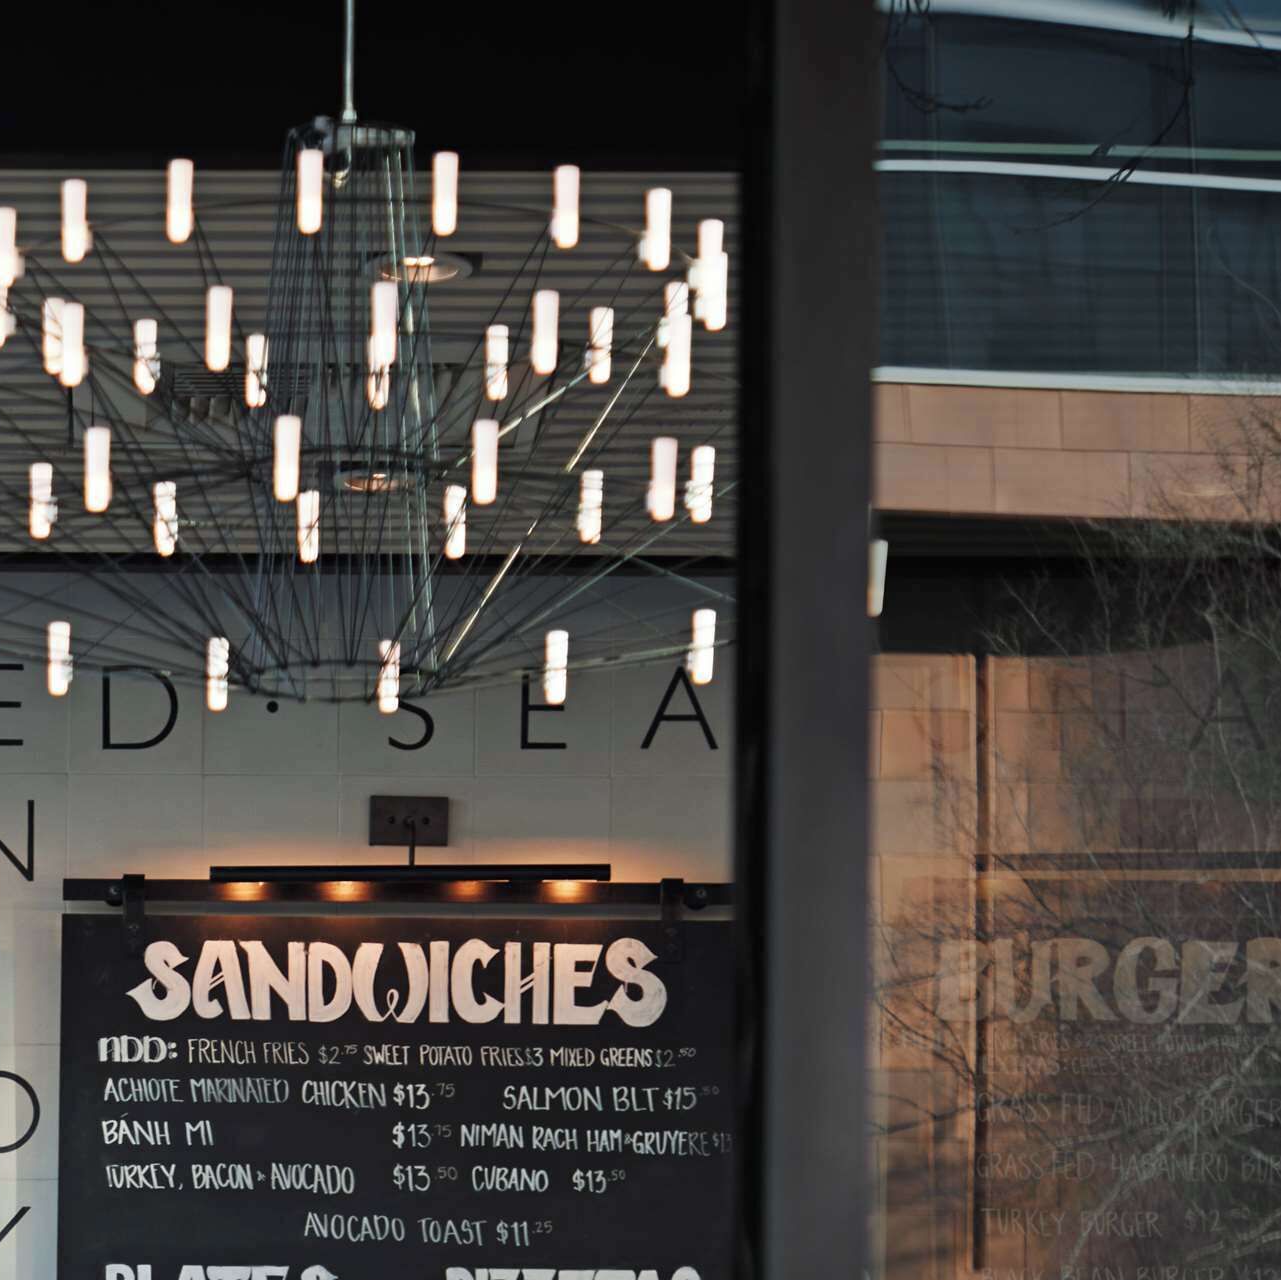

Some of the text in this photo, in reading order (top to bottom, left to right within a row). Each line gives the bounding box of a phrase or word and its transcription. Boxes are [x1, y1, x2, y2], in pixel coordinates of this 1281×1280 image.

[125, 938, 667, 1027] SANDWICHES
[187, 1039, 256, 1064] FRENCH
[263, 1041, 310, 1065] FRIES
[363, 1045, 410, 1066] SWEET
[420, 1046, 472, 1067] POTATO
[480, 1046, 524, 1067] FRIES
[550, 1047, 595, 1067] MIXED
[600, 1049, 652, 1068] GREENS
[104, 1077, 184, 1103] ACHIOTE
[302, 1080, 387, 1109] CHICKEN
[503, 1085, 660, 1112] SALMON BLT
[185, 1120, 214, 1146] MI
[460, 1123, 523, 1149] NIMAN
[532, 1127, 578, 1151] RACH
[587, 1129, 622, 1152] HAM
[192, 1163, 254, 1190] BACON
[271, 1162, 355, 1194] AVOCADO
[472, 1166, 549, 1192] CUBANO
[304, 1211, 487, 1245] AVOCADO TOAST
